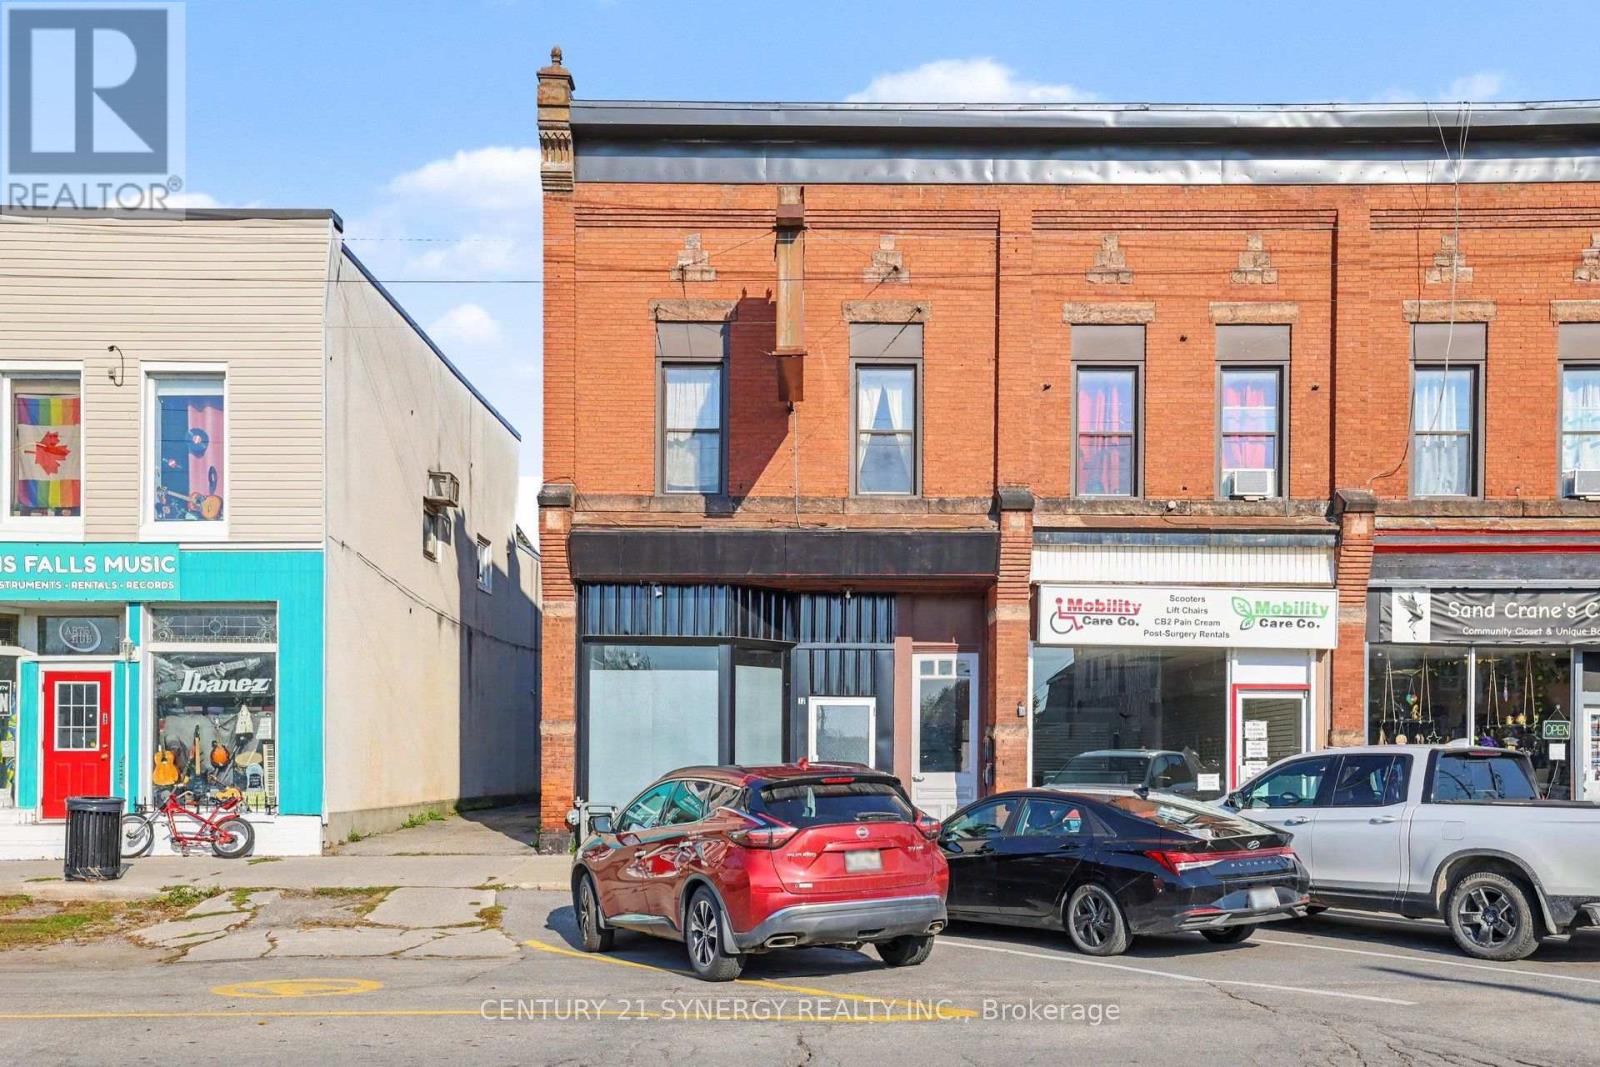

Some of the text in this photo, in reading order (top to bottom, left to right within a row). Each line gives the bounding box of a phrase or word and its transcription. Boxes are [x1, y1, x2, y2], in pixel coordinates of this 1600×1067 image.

[24, 555, 97, 573] FALLS
[104, 555, 176, 573] MUSIC
[71, 580, 118, 590] RENTALS
[126, 580, 175, 590] RECORDS
[1169, 594, 1206, 604] Scooters
[1067, 597, 1142, 616] Mobility
[1166, 606, 1209, 616] Lift Chairs
[1254, 600, 1330, 619] Mobility
[1448, 601, 1496, 619] Sand
[1504, 601, 1577, 619] Crane's
[1082, 615, 1140, 627] Care Co.
[1174, 619, 1192, 627] Pain
[1194, 619, 1221, 628] Cream
[1259, 618, 1321, 629] Care Co.
[1143, 629, 1230, 640] Post-Surgery Rentals
[1462, 626, 1512, 637] Community
[1515, 627, 1542, 636] Closet
[1546, 627, 1552, 636] &
[1556, 626, 1587, 637] Unique
[176, 669, 272, 694] Ibanez
[1545, 724, 1569, 735] OPEN
